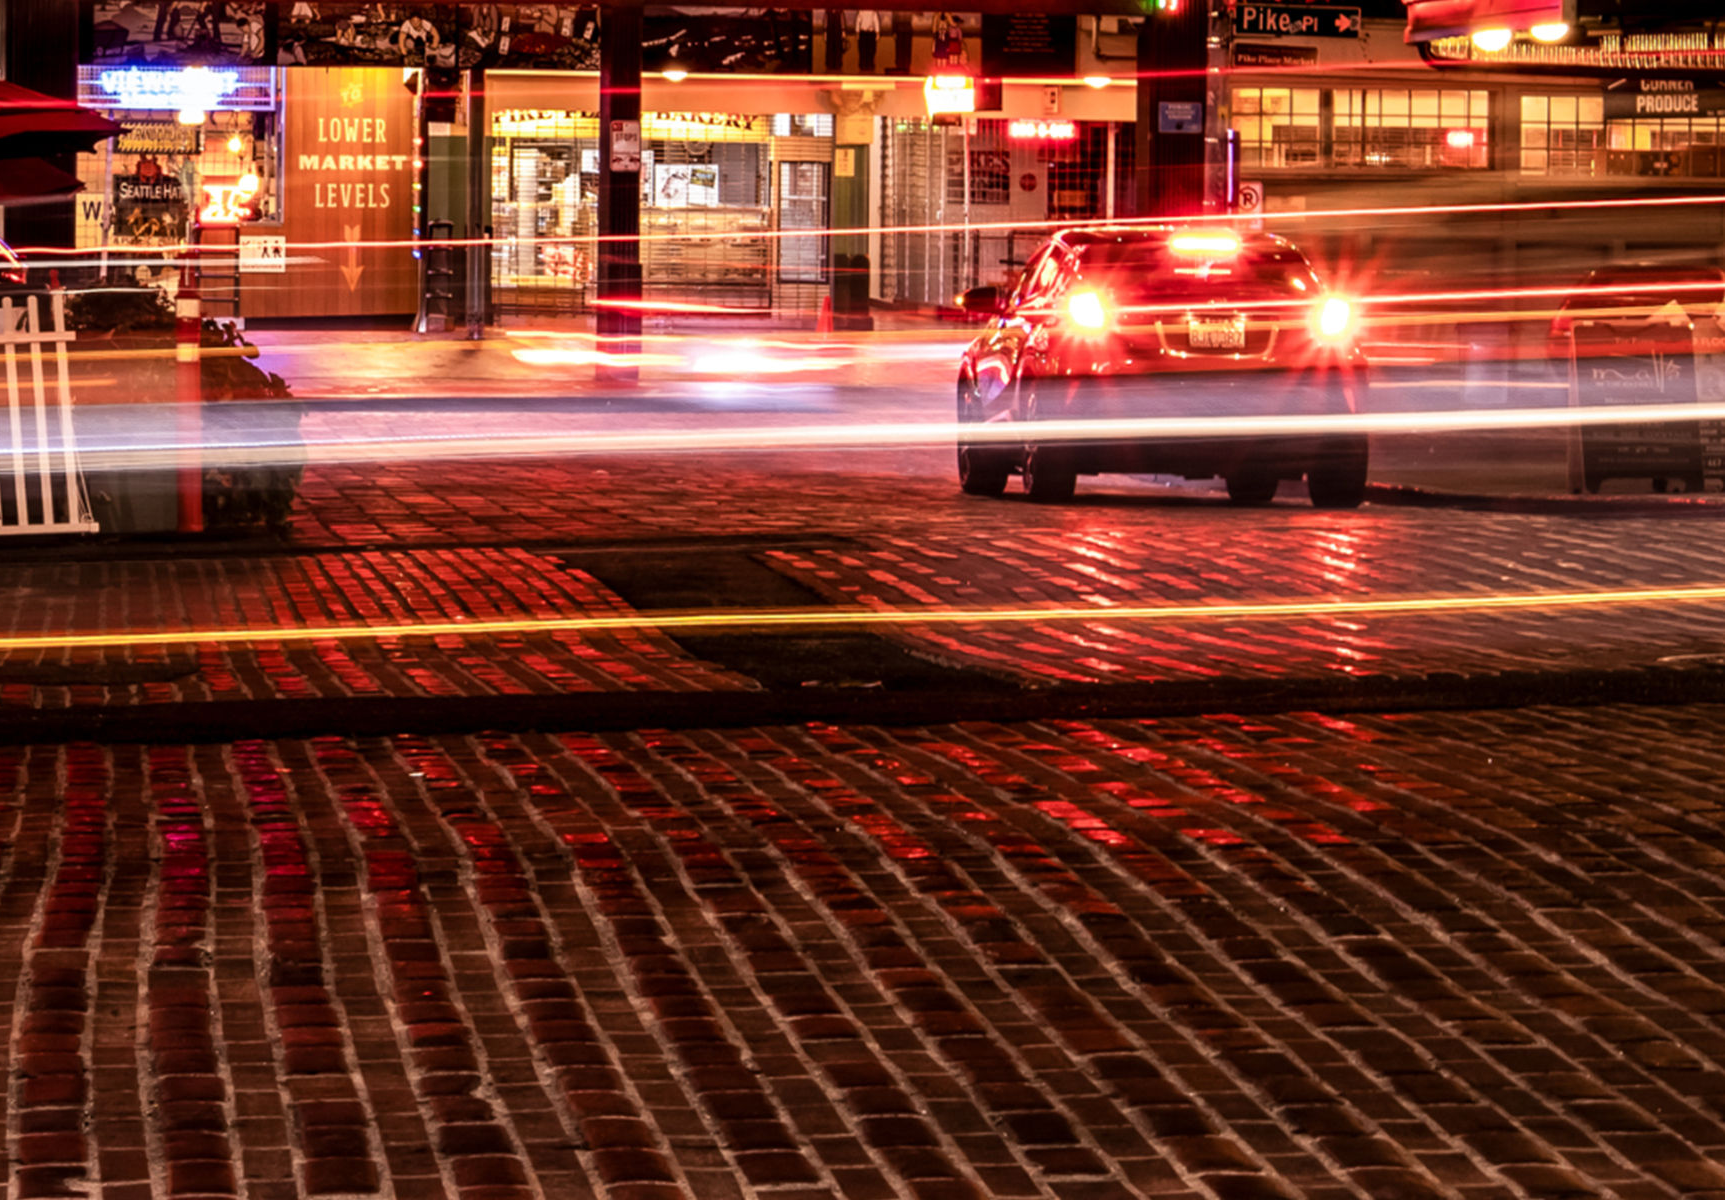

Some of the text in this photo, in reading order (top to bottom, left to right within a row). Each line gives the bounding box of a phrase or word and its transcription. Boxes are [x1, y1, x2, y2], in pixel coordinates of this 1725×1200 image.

[1243, 6, 1291, 32] Pike
[1636, 94, 1699, 113] PRODUCE
[318, 117, 386, 143] LOWER
[298, 154, 407, 171] MARKET
[119, 182, 162, 200] SEATTLE
[315, 183, 390, 208] LEVELS
